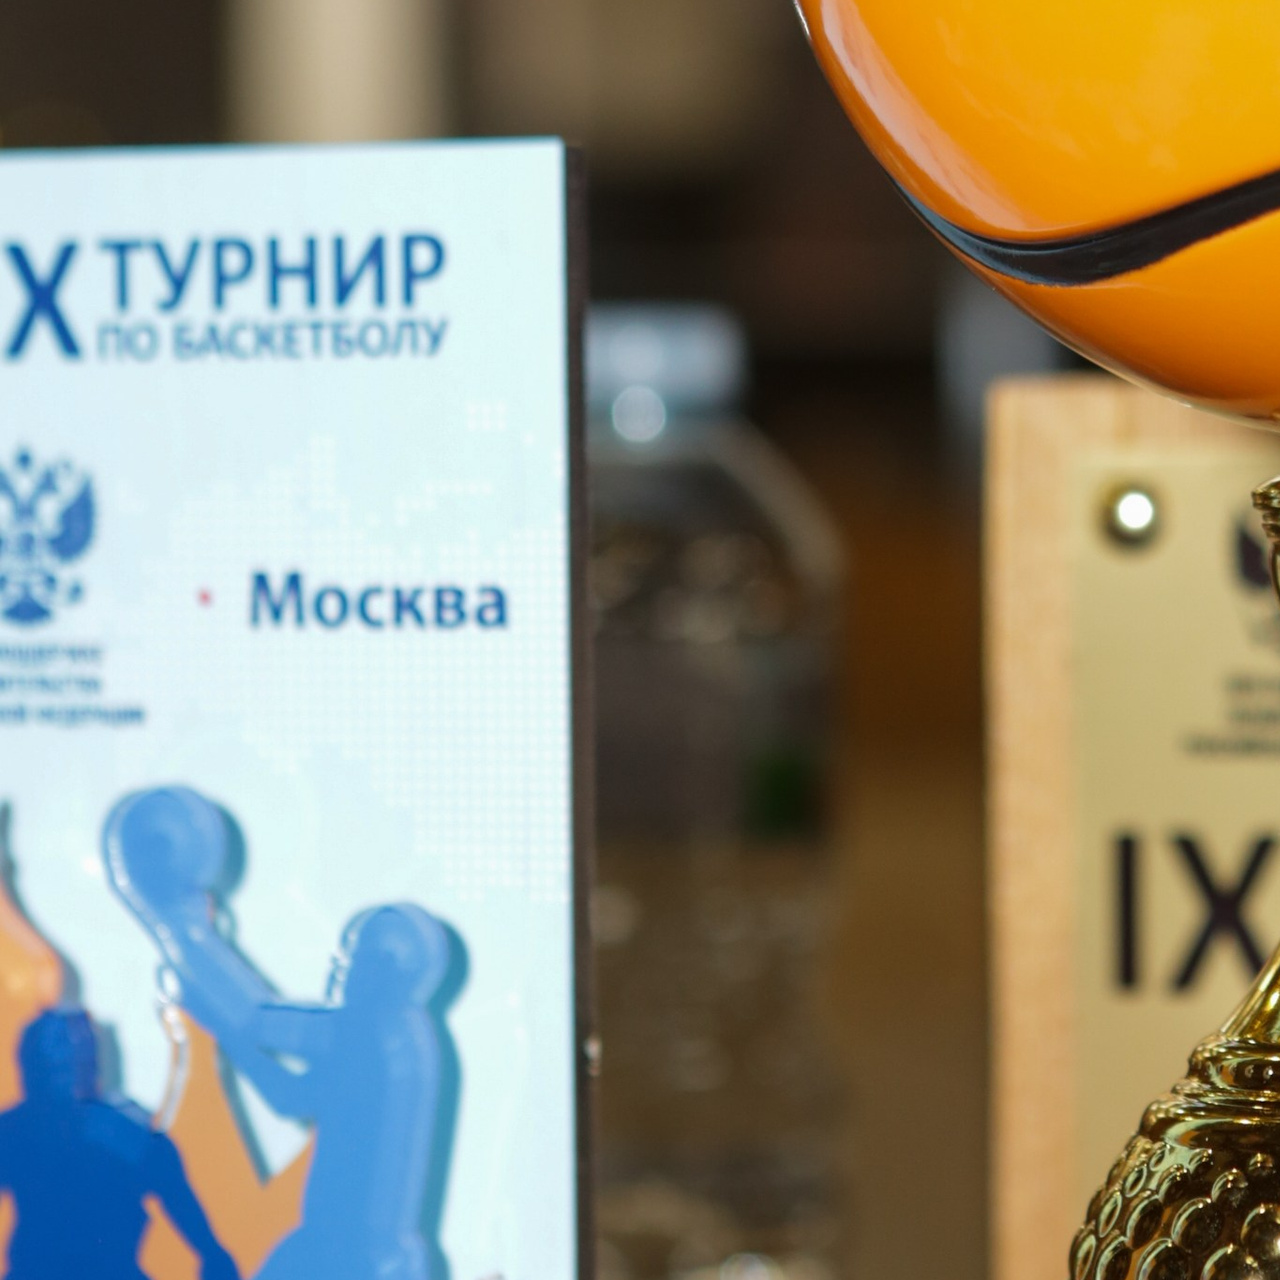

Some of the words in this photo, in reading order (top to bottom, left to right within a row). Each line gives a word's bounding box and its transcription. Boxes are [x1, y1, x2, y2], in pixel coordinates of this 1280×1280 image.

[5, 241, 83, 361] X
[101, 233, 447, 313] ТУРНИР
[100, 319, 159, 361] ПО
[174, 318, 450, 361] БАСКЕТБОЛУ
[250, 571, 510, 629] Москва
[1114, 829, 1276, 995] IX
